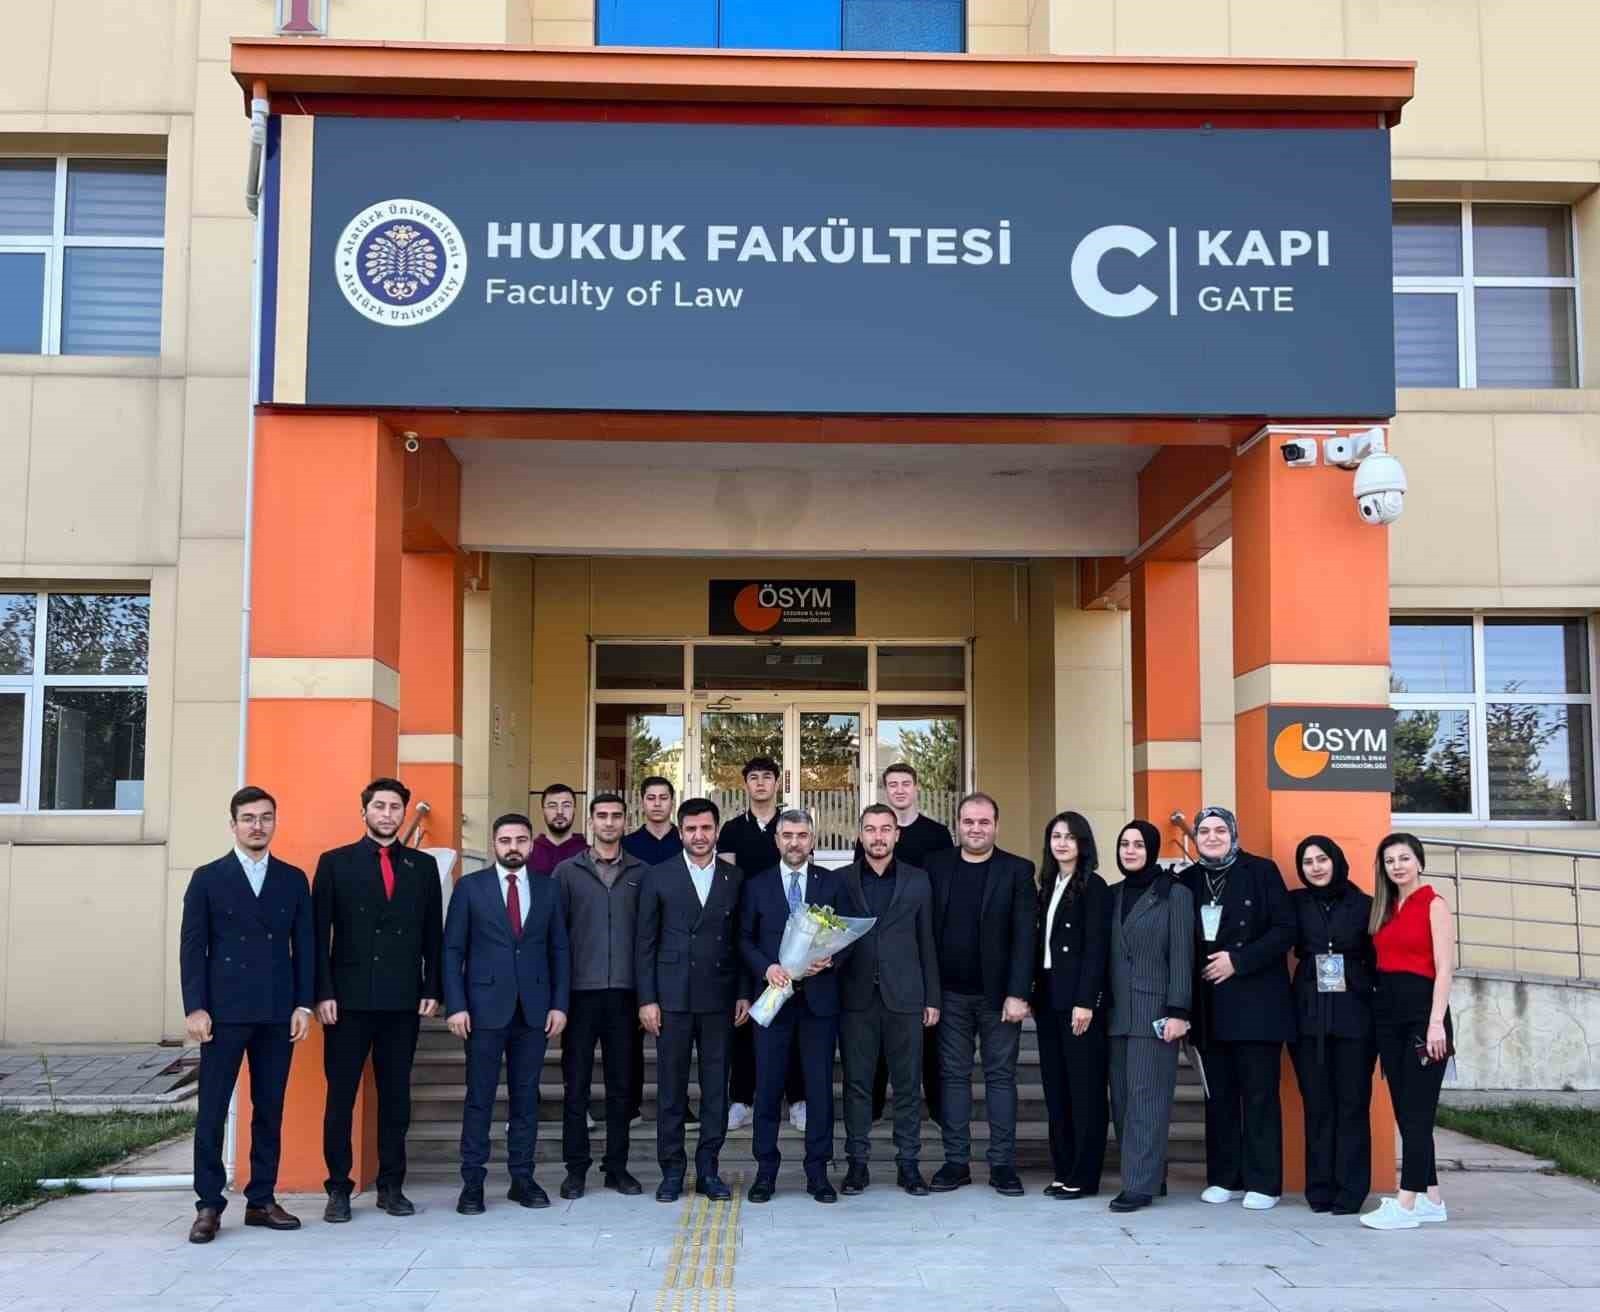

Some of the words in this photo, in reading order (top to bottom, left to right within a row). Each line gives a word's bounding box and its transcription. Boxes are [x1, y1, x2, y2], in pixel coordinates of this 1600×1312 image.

[343, 209, 384, 256] Atatürk
[388, 203, 460, 258] Üniversitesi
[487, 221, 687, 262] HUKUK
[707, 217, 1011, 265] FAKÜLTESİ
[1198, 229, 1330, 267] KAPI
[1070, 224, 1159, 318] C
[343, 273, 385, 317] Atatürk
[390, 276, 459, 320] University
[486, 278, 614, 311] Faculty
[626, 279, 663, 307] of
[674, 281, 744, 308] Law
[1198, 286, 1295, 312] GATE
[758, 583, 832, 608] ÖSYM
[1302, 722, 1388, 752] ÖSYM
